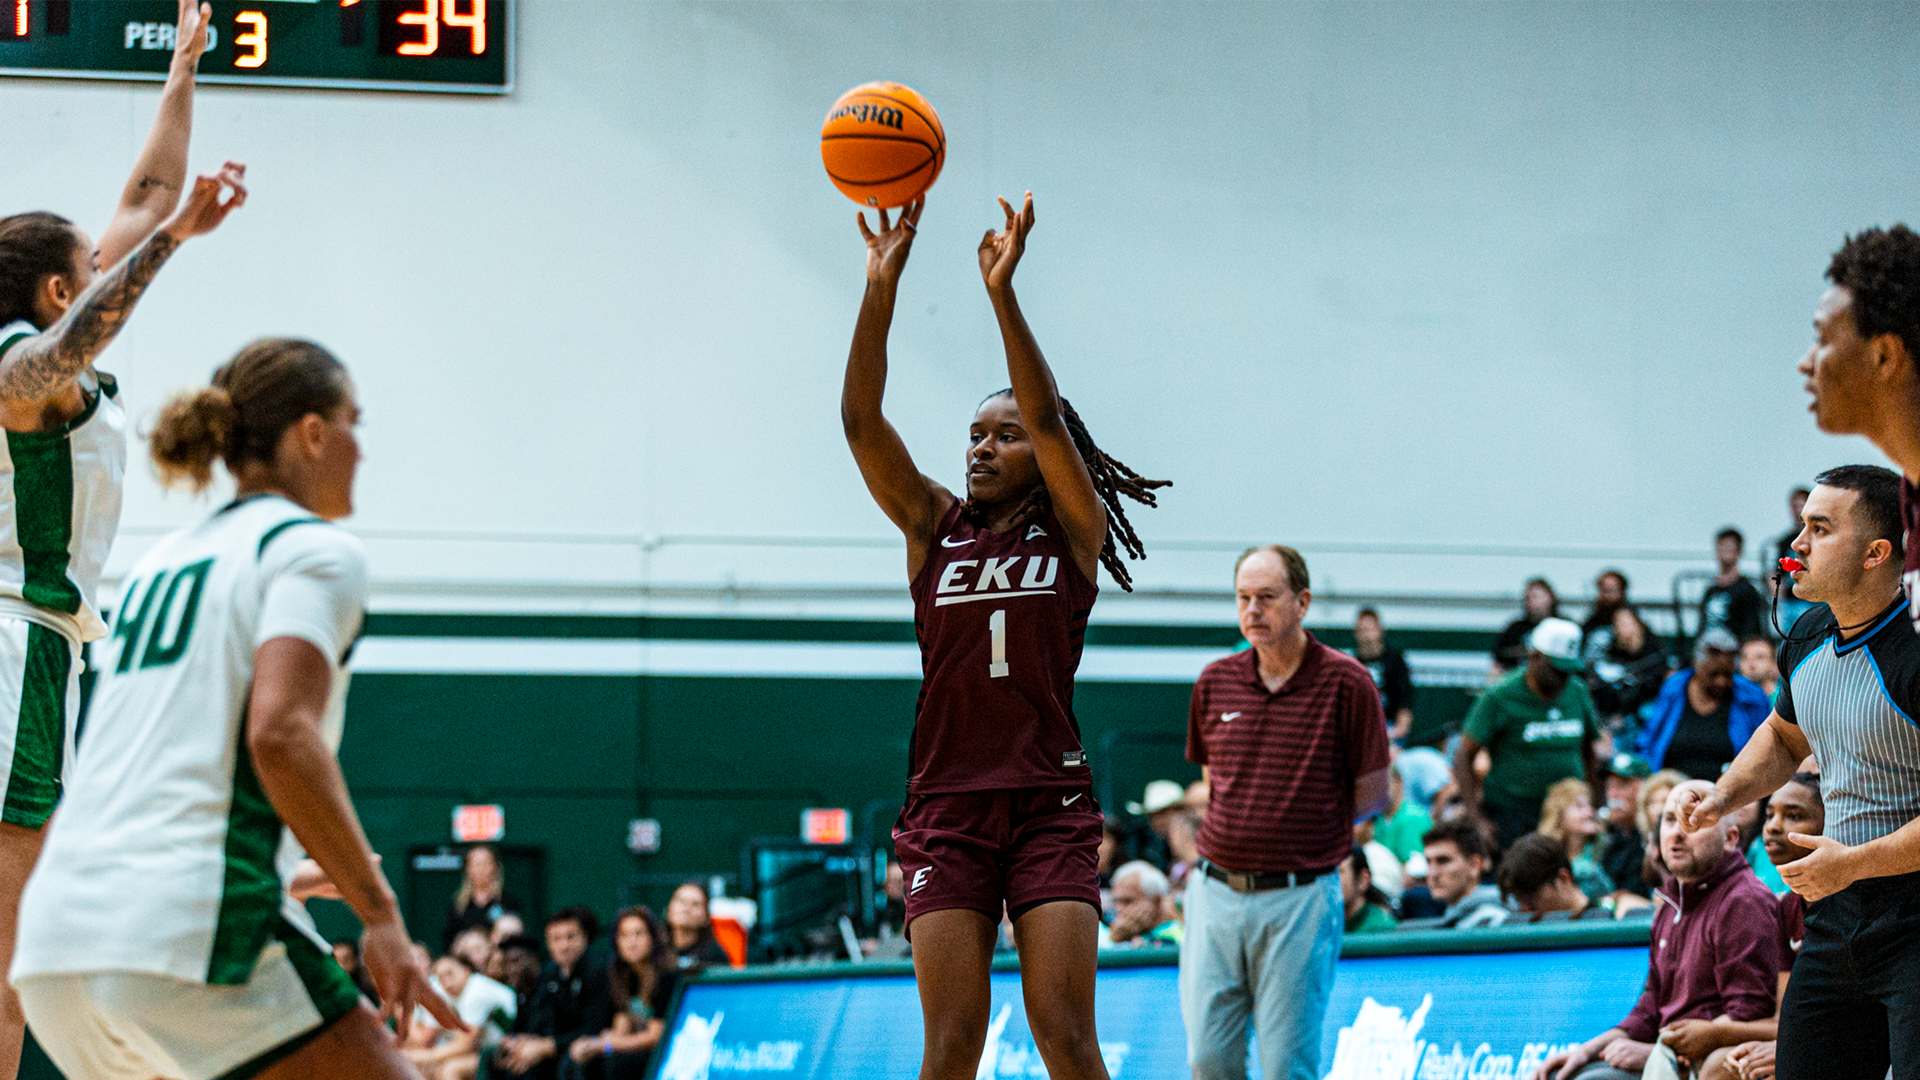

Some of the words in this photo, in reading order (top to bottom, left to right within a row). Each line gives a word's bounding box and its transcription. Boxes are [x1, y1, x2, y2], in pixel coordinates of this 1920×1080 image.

[124, 22, 218, 52] PERD
[234, 10, 268, 68] 3
[396, 0, 486, 55] 34
[829, 103, 904, 131] Wilson
[936, 556, 1059, 594] EKU
[113, 556, 217, 676] 40
[989, 609, 1010, 679] 1
[911, 866, 933, 891] E
